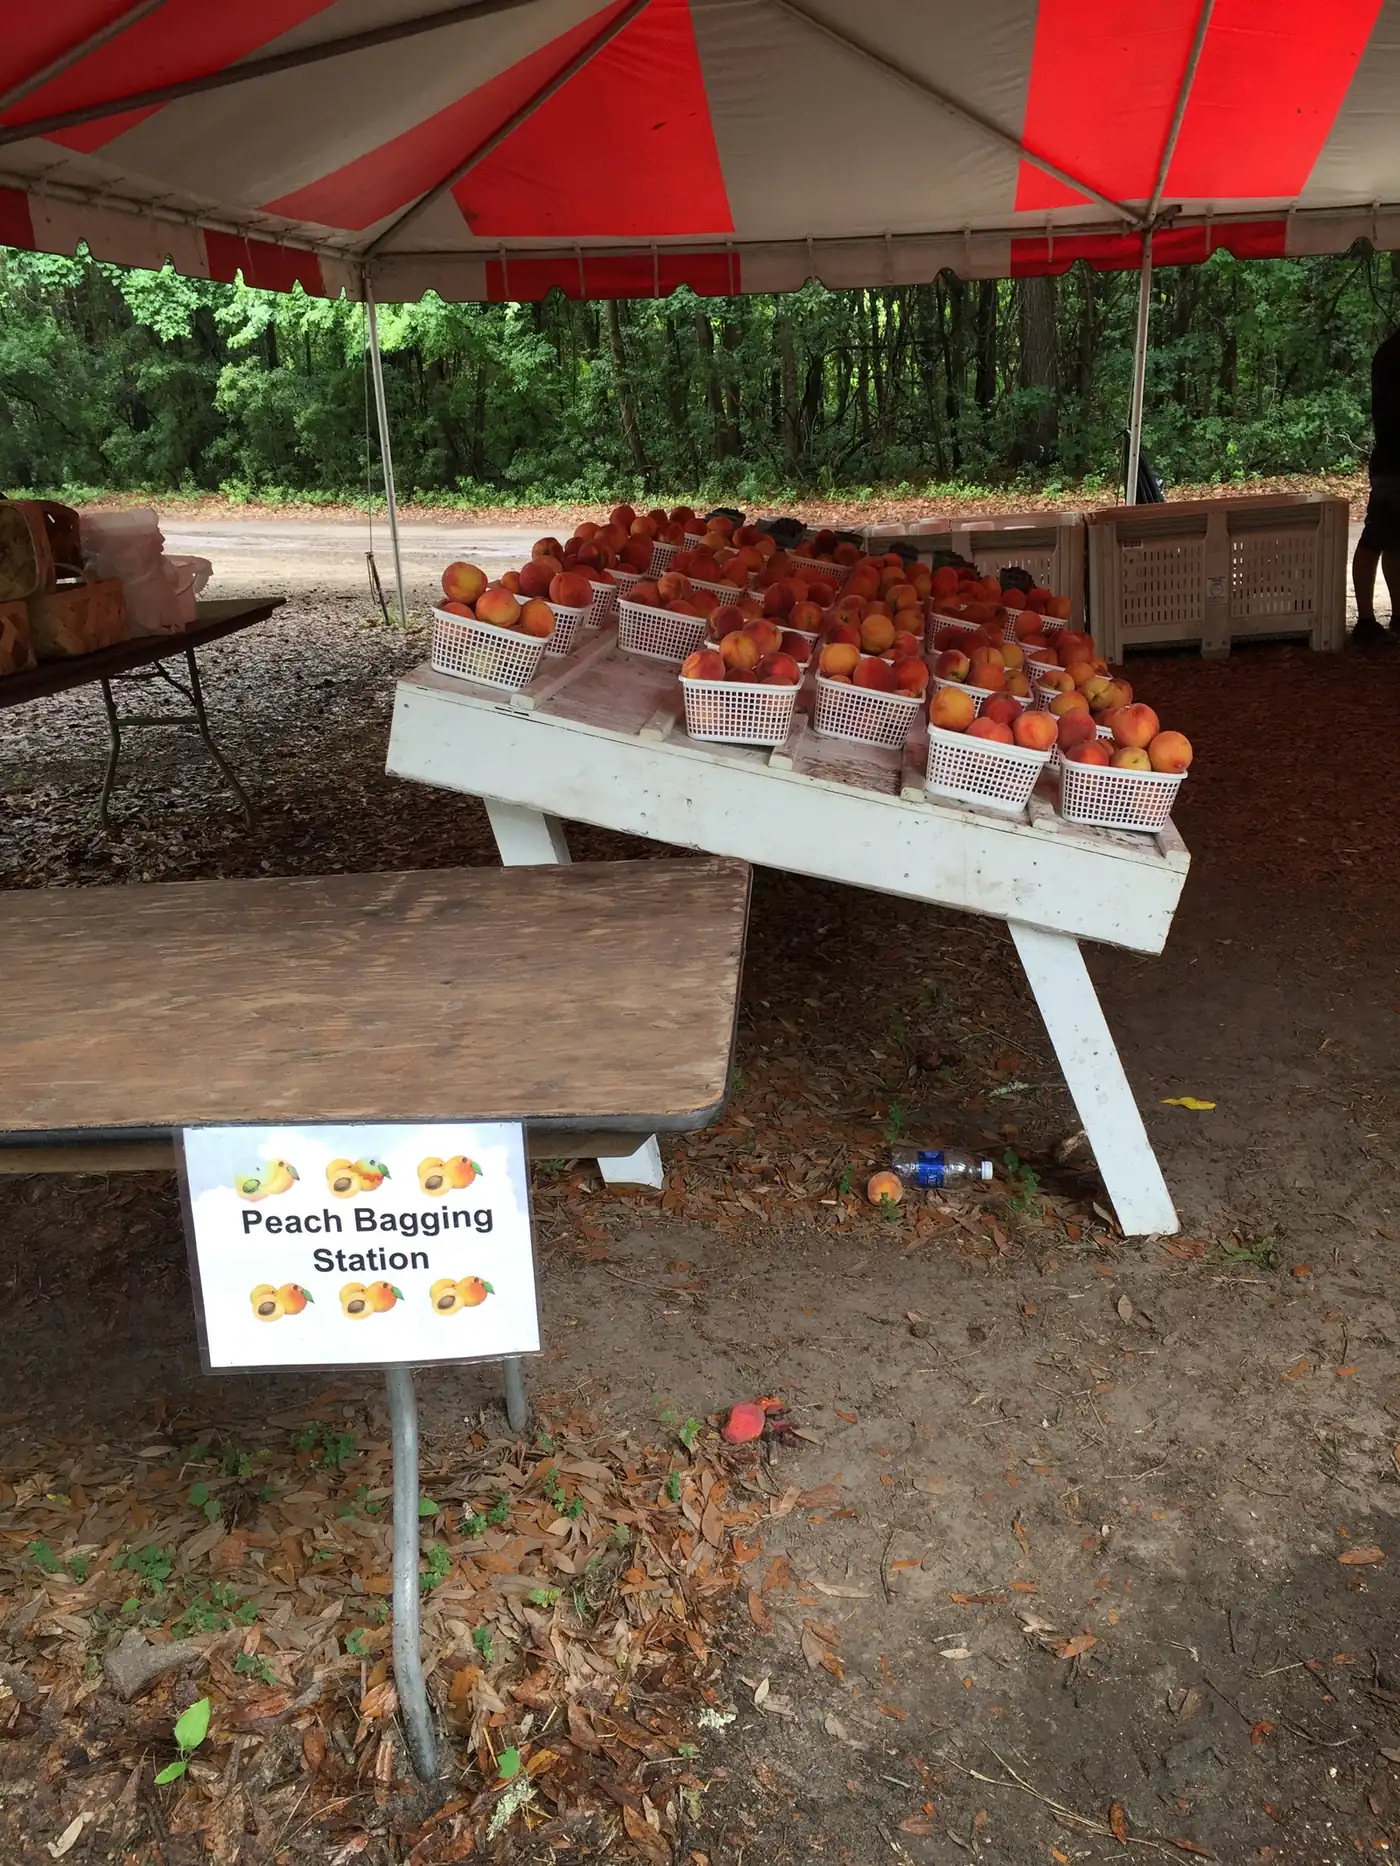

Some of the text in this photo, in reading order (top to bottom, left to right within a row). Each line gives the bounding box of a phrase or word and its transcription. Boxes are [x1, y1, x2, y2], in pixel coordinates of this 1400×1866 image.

[241, 1206, 494, 1237] Peach Bagging
[313, 1247, 429, 1273] Station
